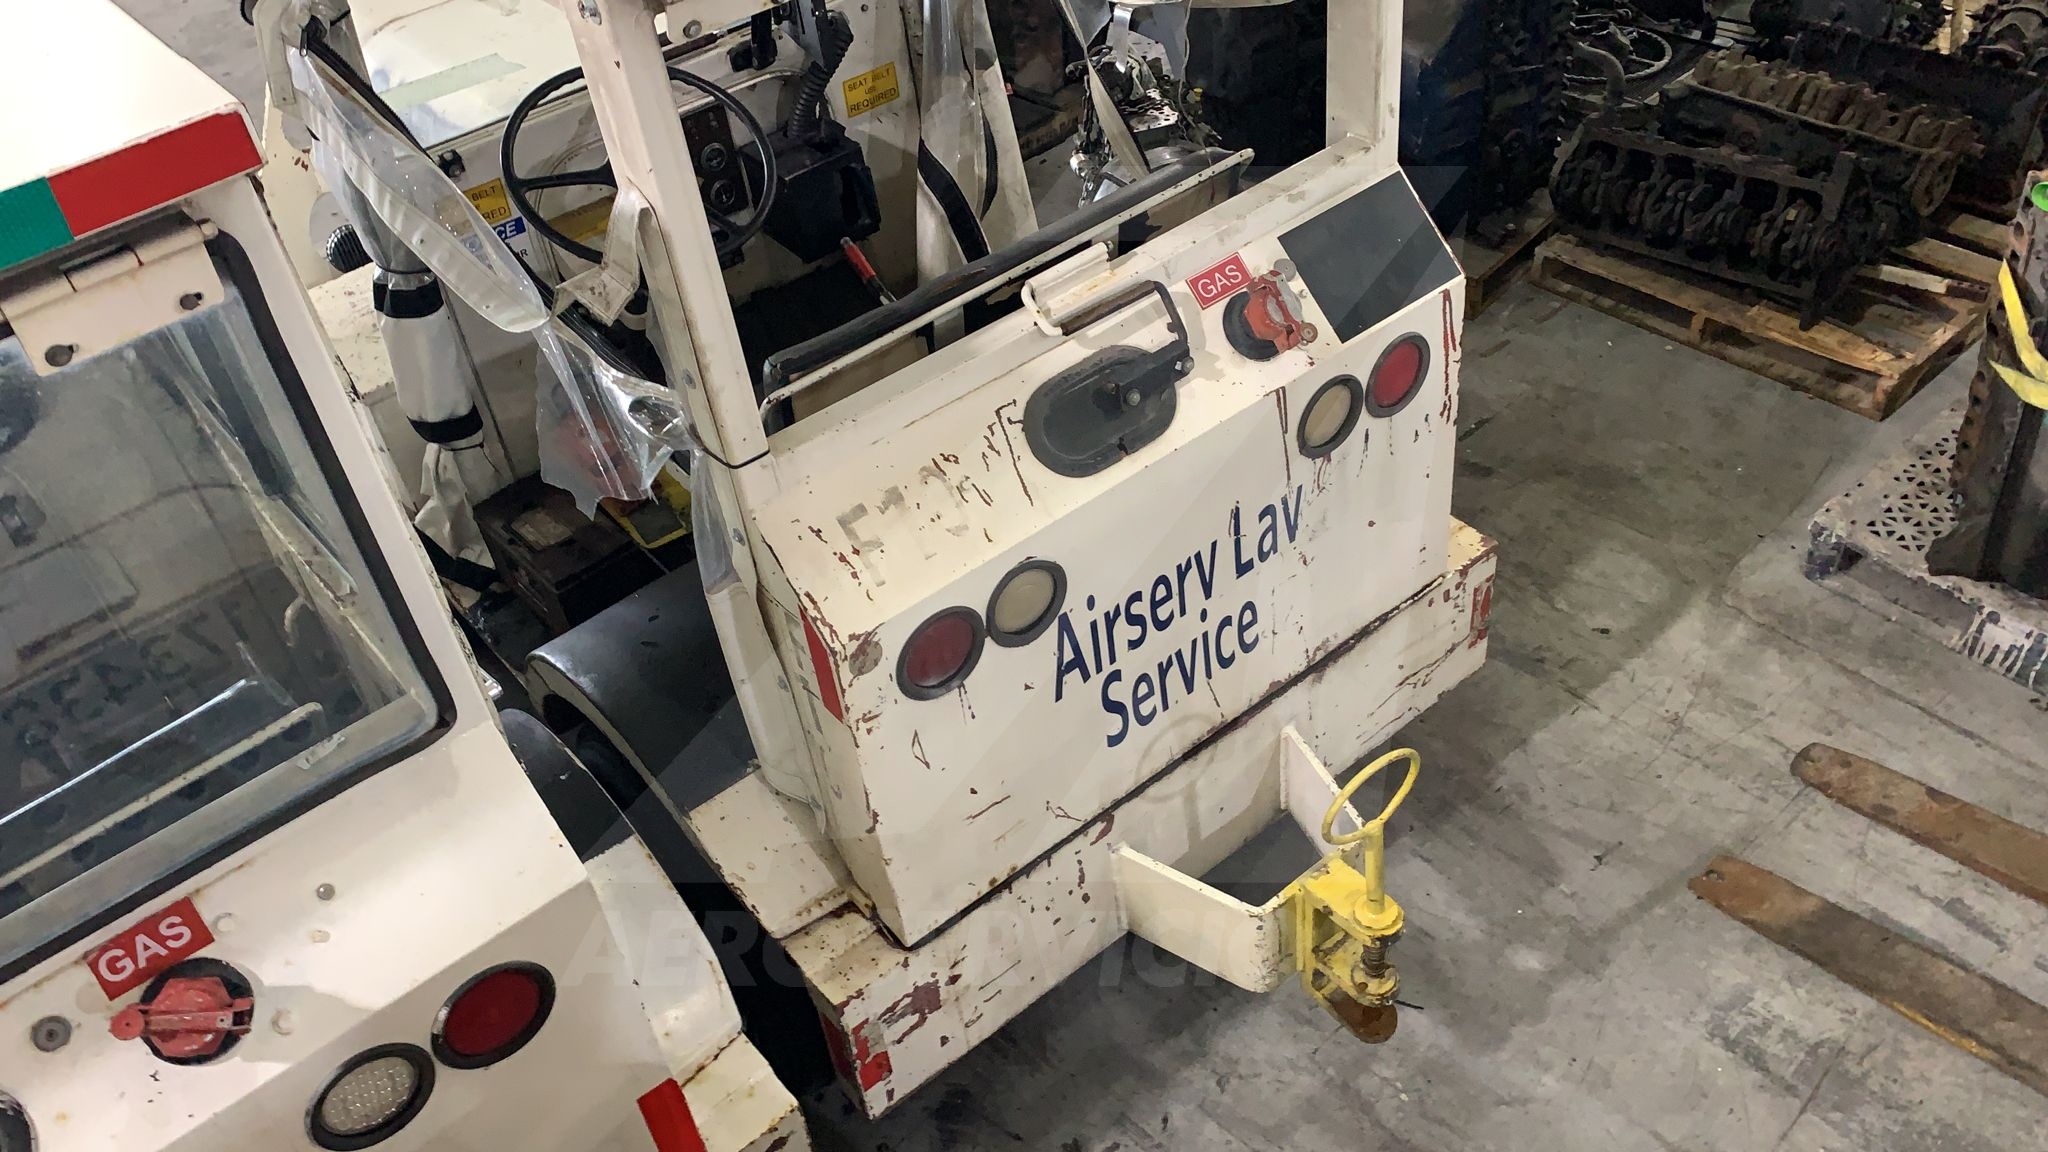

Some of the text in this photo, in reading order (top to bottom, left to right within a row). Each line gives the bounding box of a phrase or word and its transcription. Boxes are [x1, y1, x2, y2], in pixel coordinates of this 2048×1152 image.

[847, 77, 868, 92] SEAT
[850, 87, 897, 113] REQUIRED
[471, 185, 497, 202] BELT
[495, 220, 517, 239] CE
[1197, 264, 1242, 298] GAS
[1054, 484, 1303, 703] Airserv Lav
[1101, 600, 1260, 748] Service
[97, 915, 192, 983] GAS
